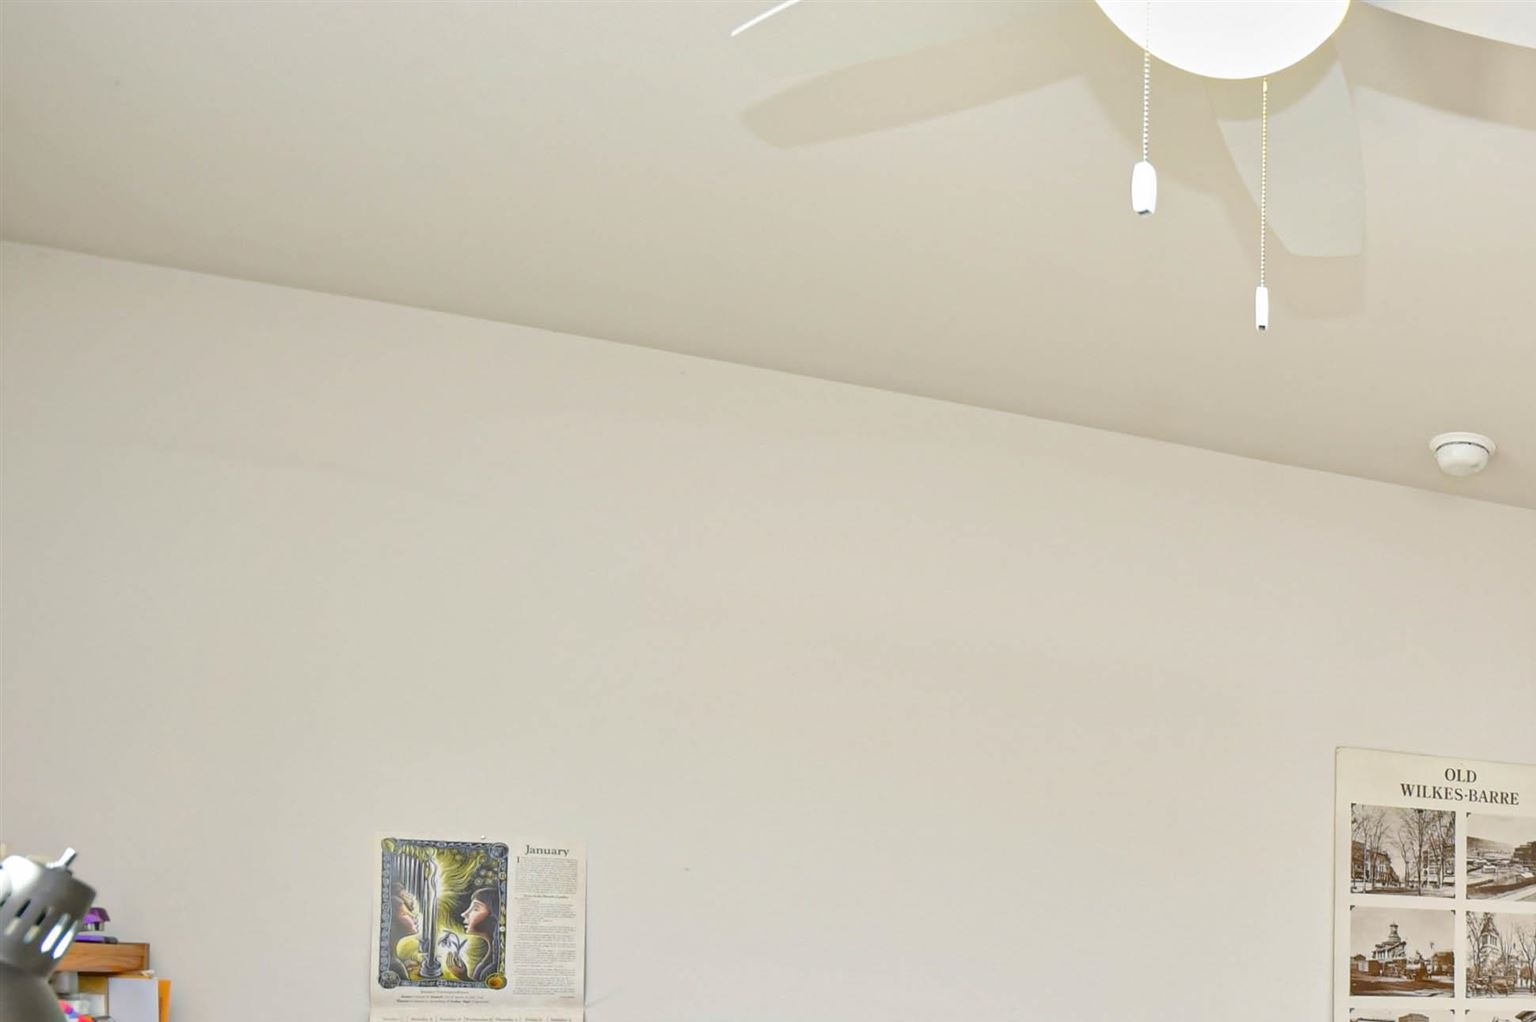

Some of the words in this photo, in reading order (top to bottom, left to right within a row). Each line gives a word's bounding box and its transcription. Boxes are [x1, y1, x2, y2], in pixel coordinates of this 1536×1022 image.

[1444, 768, 1477, 784] OLD
[1400, 783, 1519, 806] WILKES-BARRE
[525, 844, 569, 858] January
